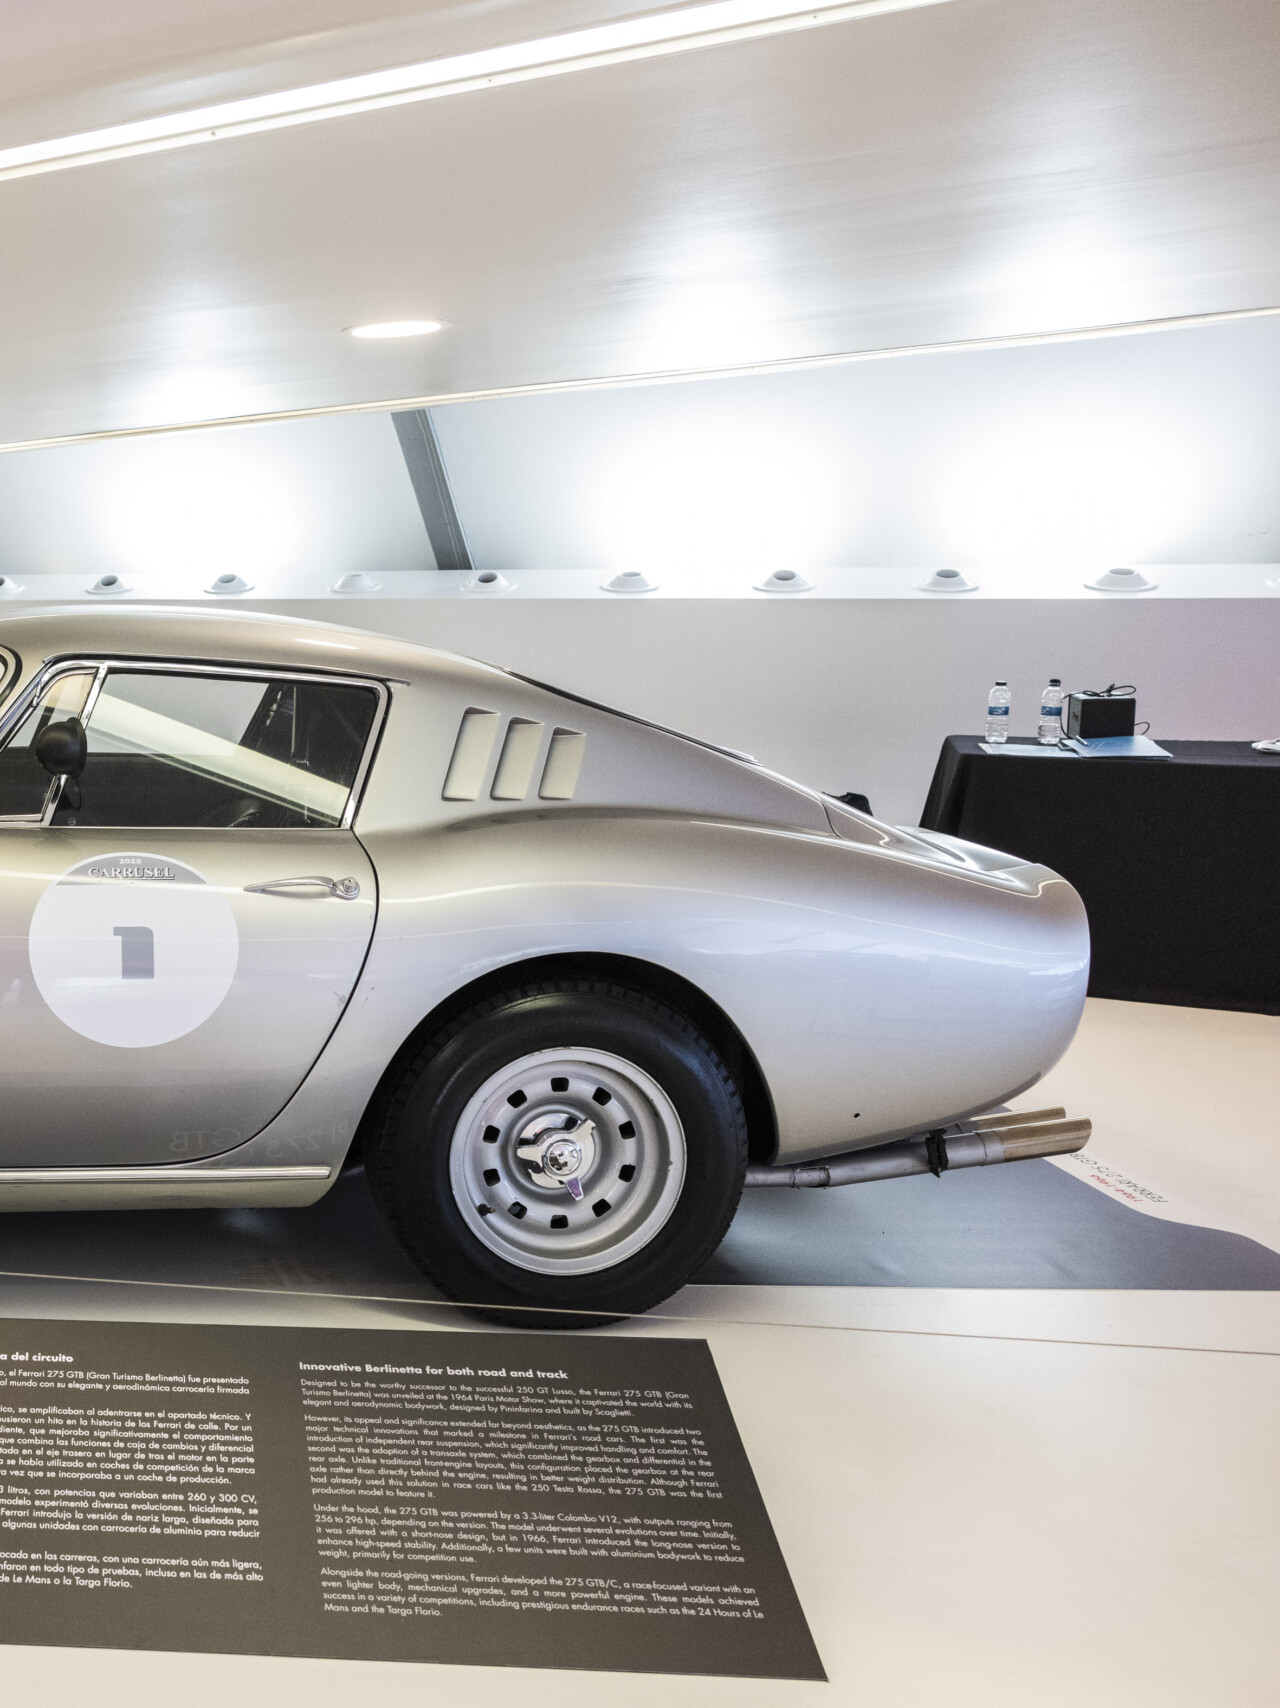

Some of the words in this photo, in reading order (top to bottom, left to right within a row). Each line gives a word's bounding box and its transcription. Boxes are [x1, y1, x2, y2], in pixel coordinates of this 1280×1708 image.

[88, 866, 176, 880] CARRUSEL
[113, 926, 155, 980] 1
[10, 1351, 29, 1361] del
[31, 1352, 73, 1362] circuito
[298, 1361, 362, 1372] Innovative
[364, 1363, 423, 1374] Berlinetta
[424, 1365, 444, 1375] for
[445, 1365, 475, 1376] both
[477, 1367, 507, 1377] road
[509, 1368, 534, 1378] and
[535, 1369, 568, 1379] track
[300, 1378, 337, 1388] Designed
[363, 1380, 376, 1388] the
[379, 1381, 406, 1390] worthy
[459, 1383, 472, 1391] the
[475, 1385, 513, 1393] successful
[536, 1386, 548, 1394] GT
[551, 1387, 576, 1396] Lusso,
[578, 1387, 592, 1395] the
[593, 1388, 621, 1396] Ferrari
[623, 1389, 641, 1397] 275
[643, 1390, 662, 1398] GTB
[664, 1391, 689, 1399] (Gran
[12, 1573, 22, 1583] Le
[24, 1574, 51, 1584] Mans
[53, 1577, 60, 1585] o
[62, 1575, 72, 1585] la
[74, 1575, 101, 1588] Targa
[103, 1577, 132, 1588] Florio.
[323, 1602, 349, 1612] Mans
[351, 1603, 369, 1612] and
[370, 1604, 385, 1613] the
[386, 1604, 412, 1616] Targa
[414, 1606, 443, 1616] Florio.
